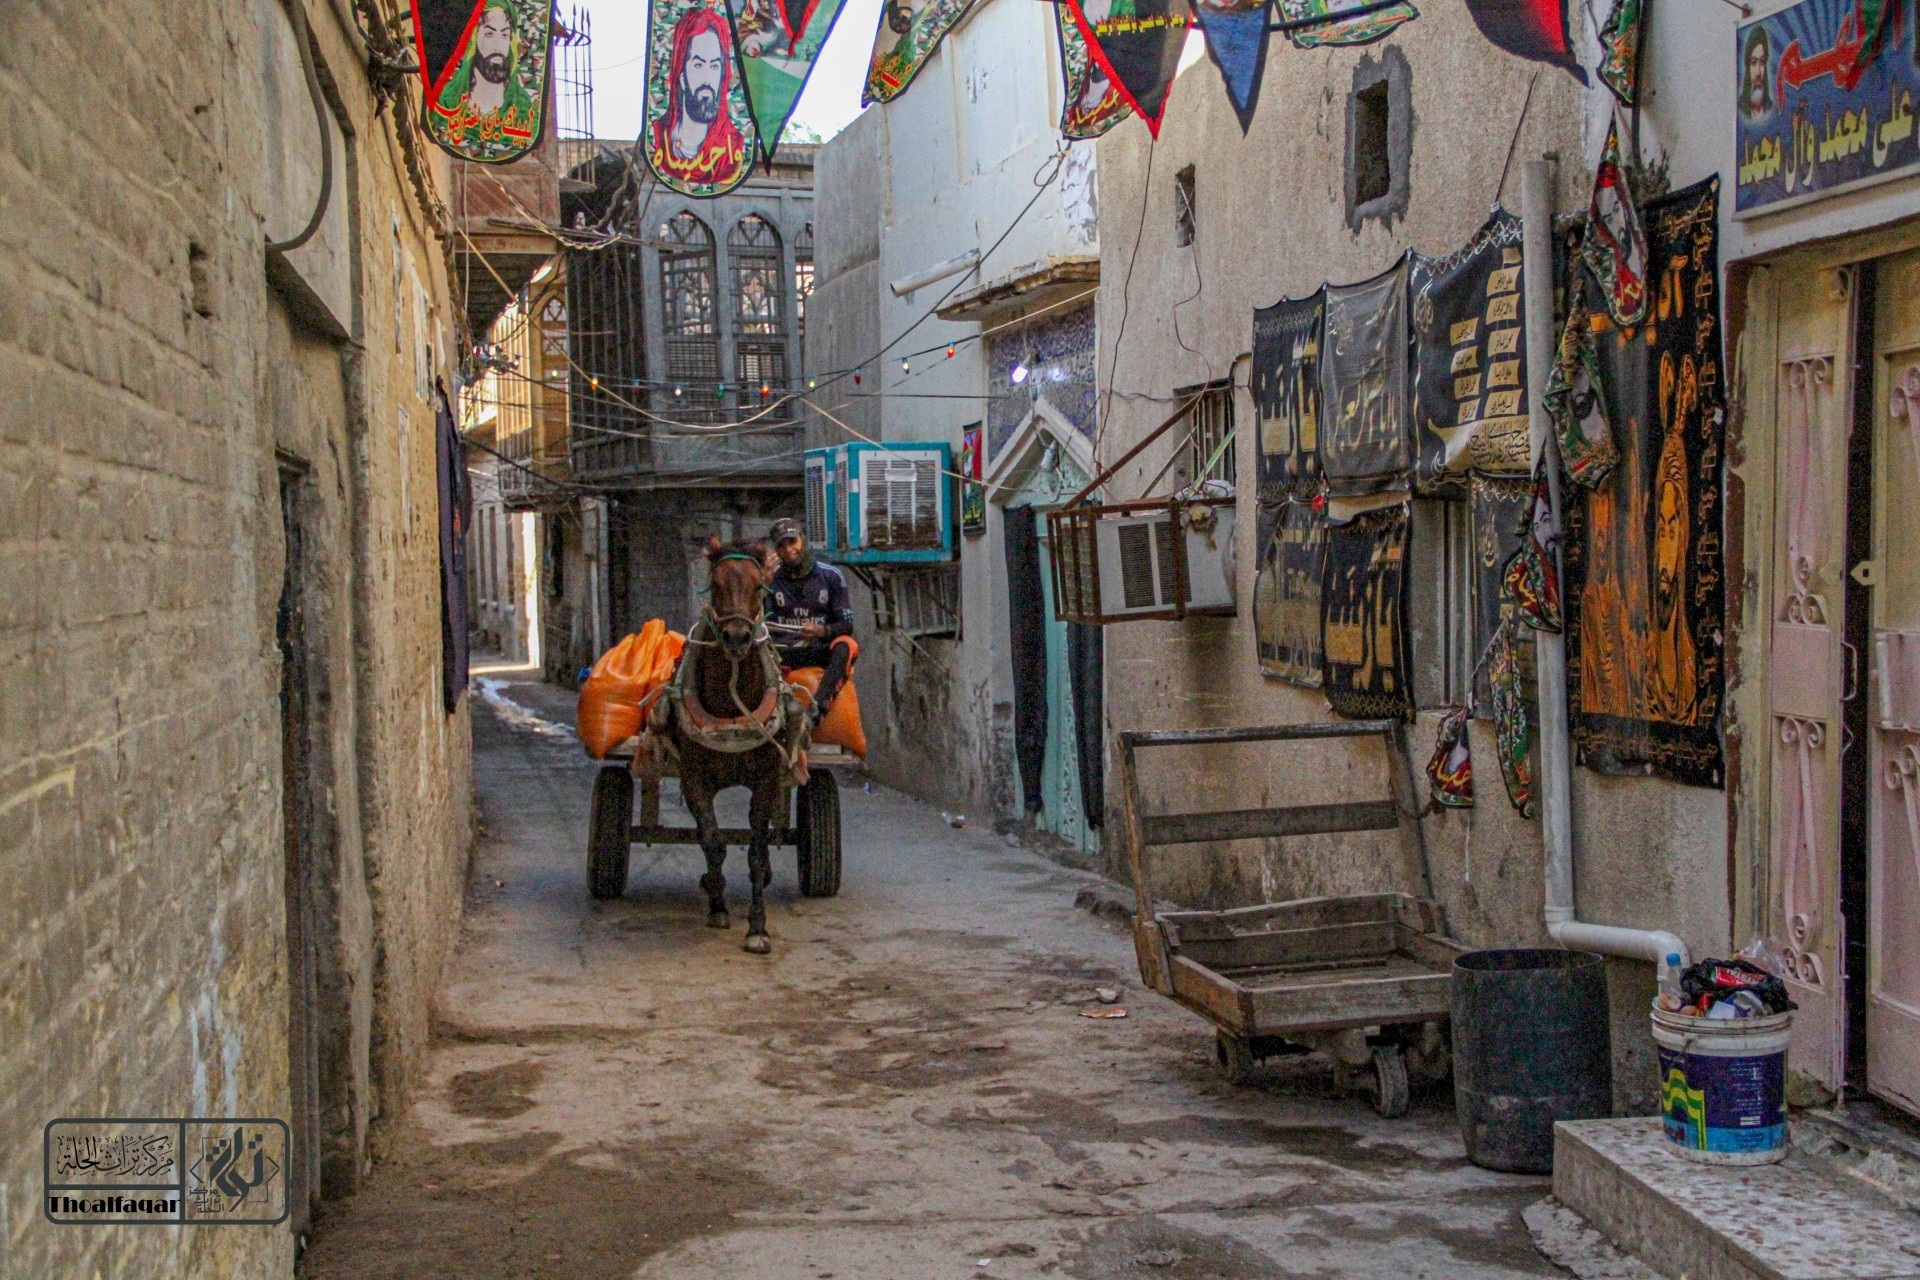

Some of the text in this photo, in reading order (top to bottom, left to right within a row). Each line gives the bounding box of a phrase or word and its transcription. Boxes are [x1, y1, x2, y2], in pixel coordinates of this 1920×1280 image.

[1739, 130, 1781, 186] محمد
[1819, 103, 1867, 164] محمد
[794, 608, 809, 616] Fly
